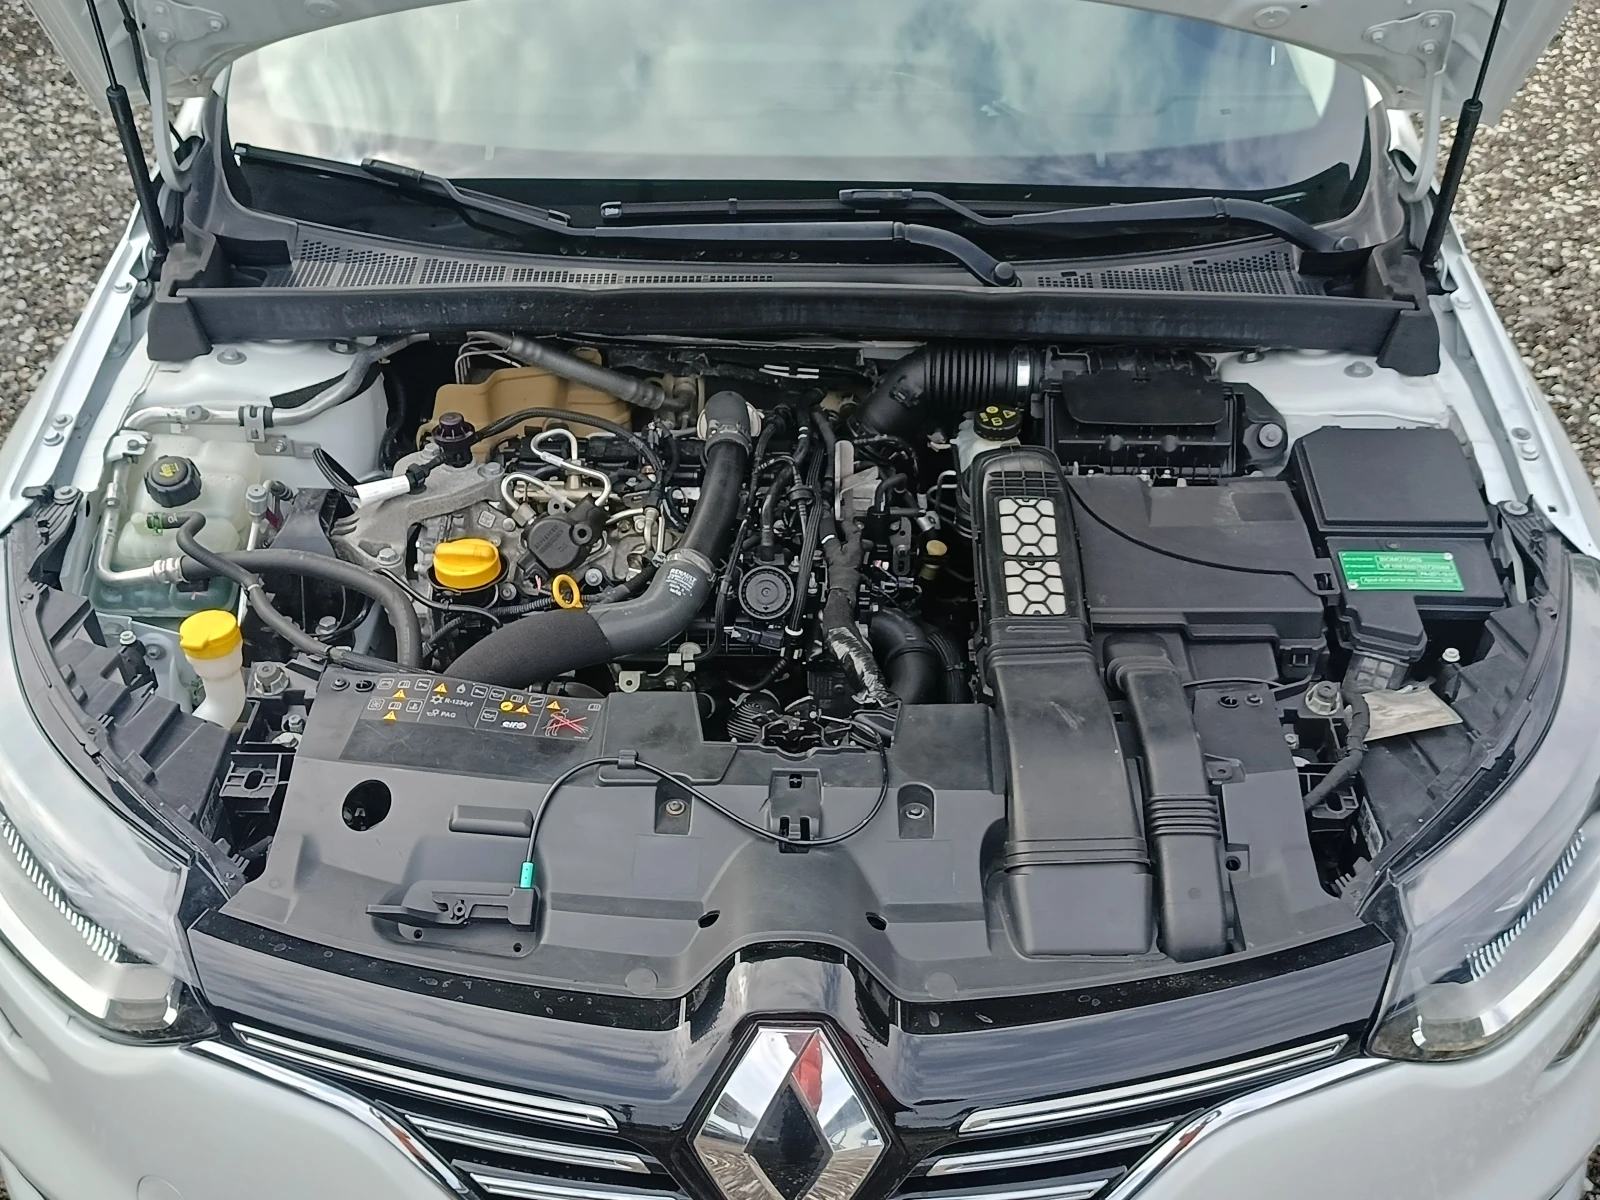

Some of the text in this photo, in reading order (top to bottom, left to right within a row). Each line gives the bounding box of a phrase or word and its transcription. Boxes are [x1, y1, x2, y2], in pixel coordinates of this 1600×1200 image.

[669, 568, 698, 583] RENAULT
[444, 697, 474, 707] R-1234yf
[440, 711, 457, 719] PAG
[501, 721, 518, 729] elf
